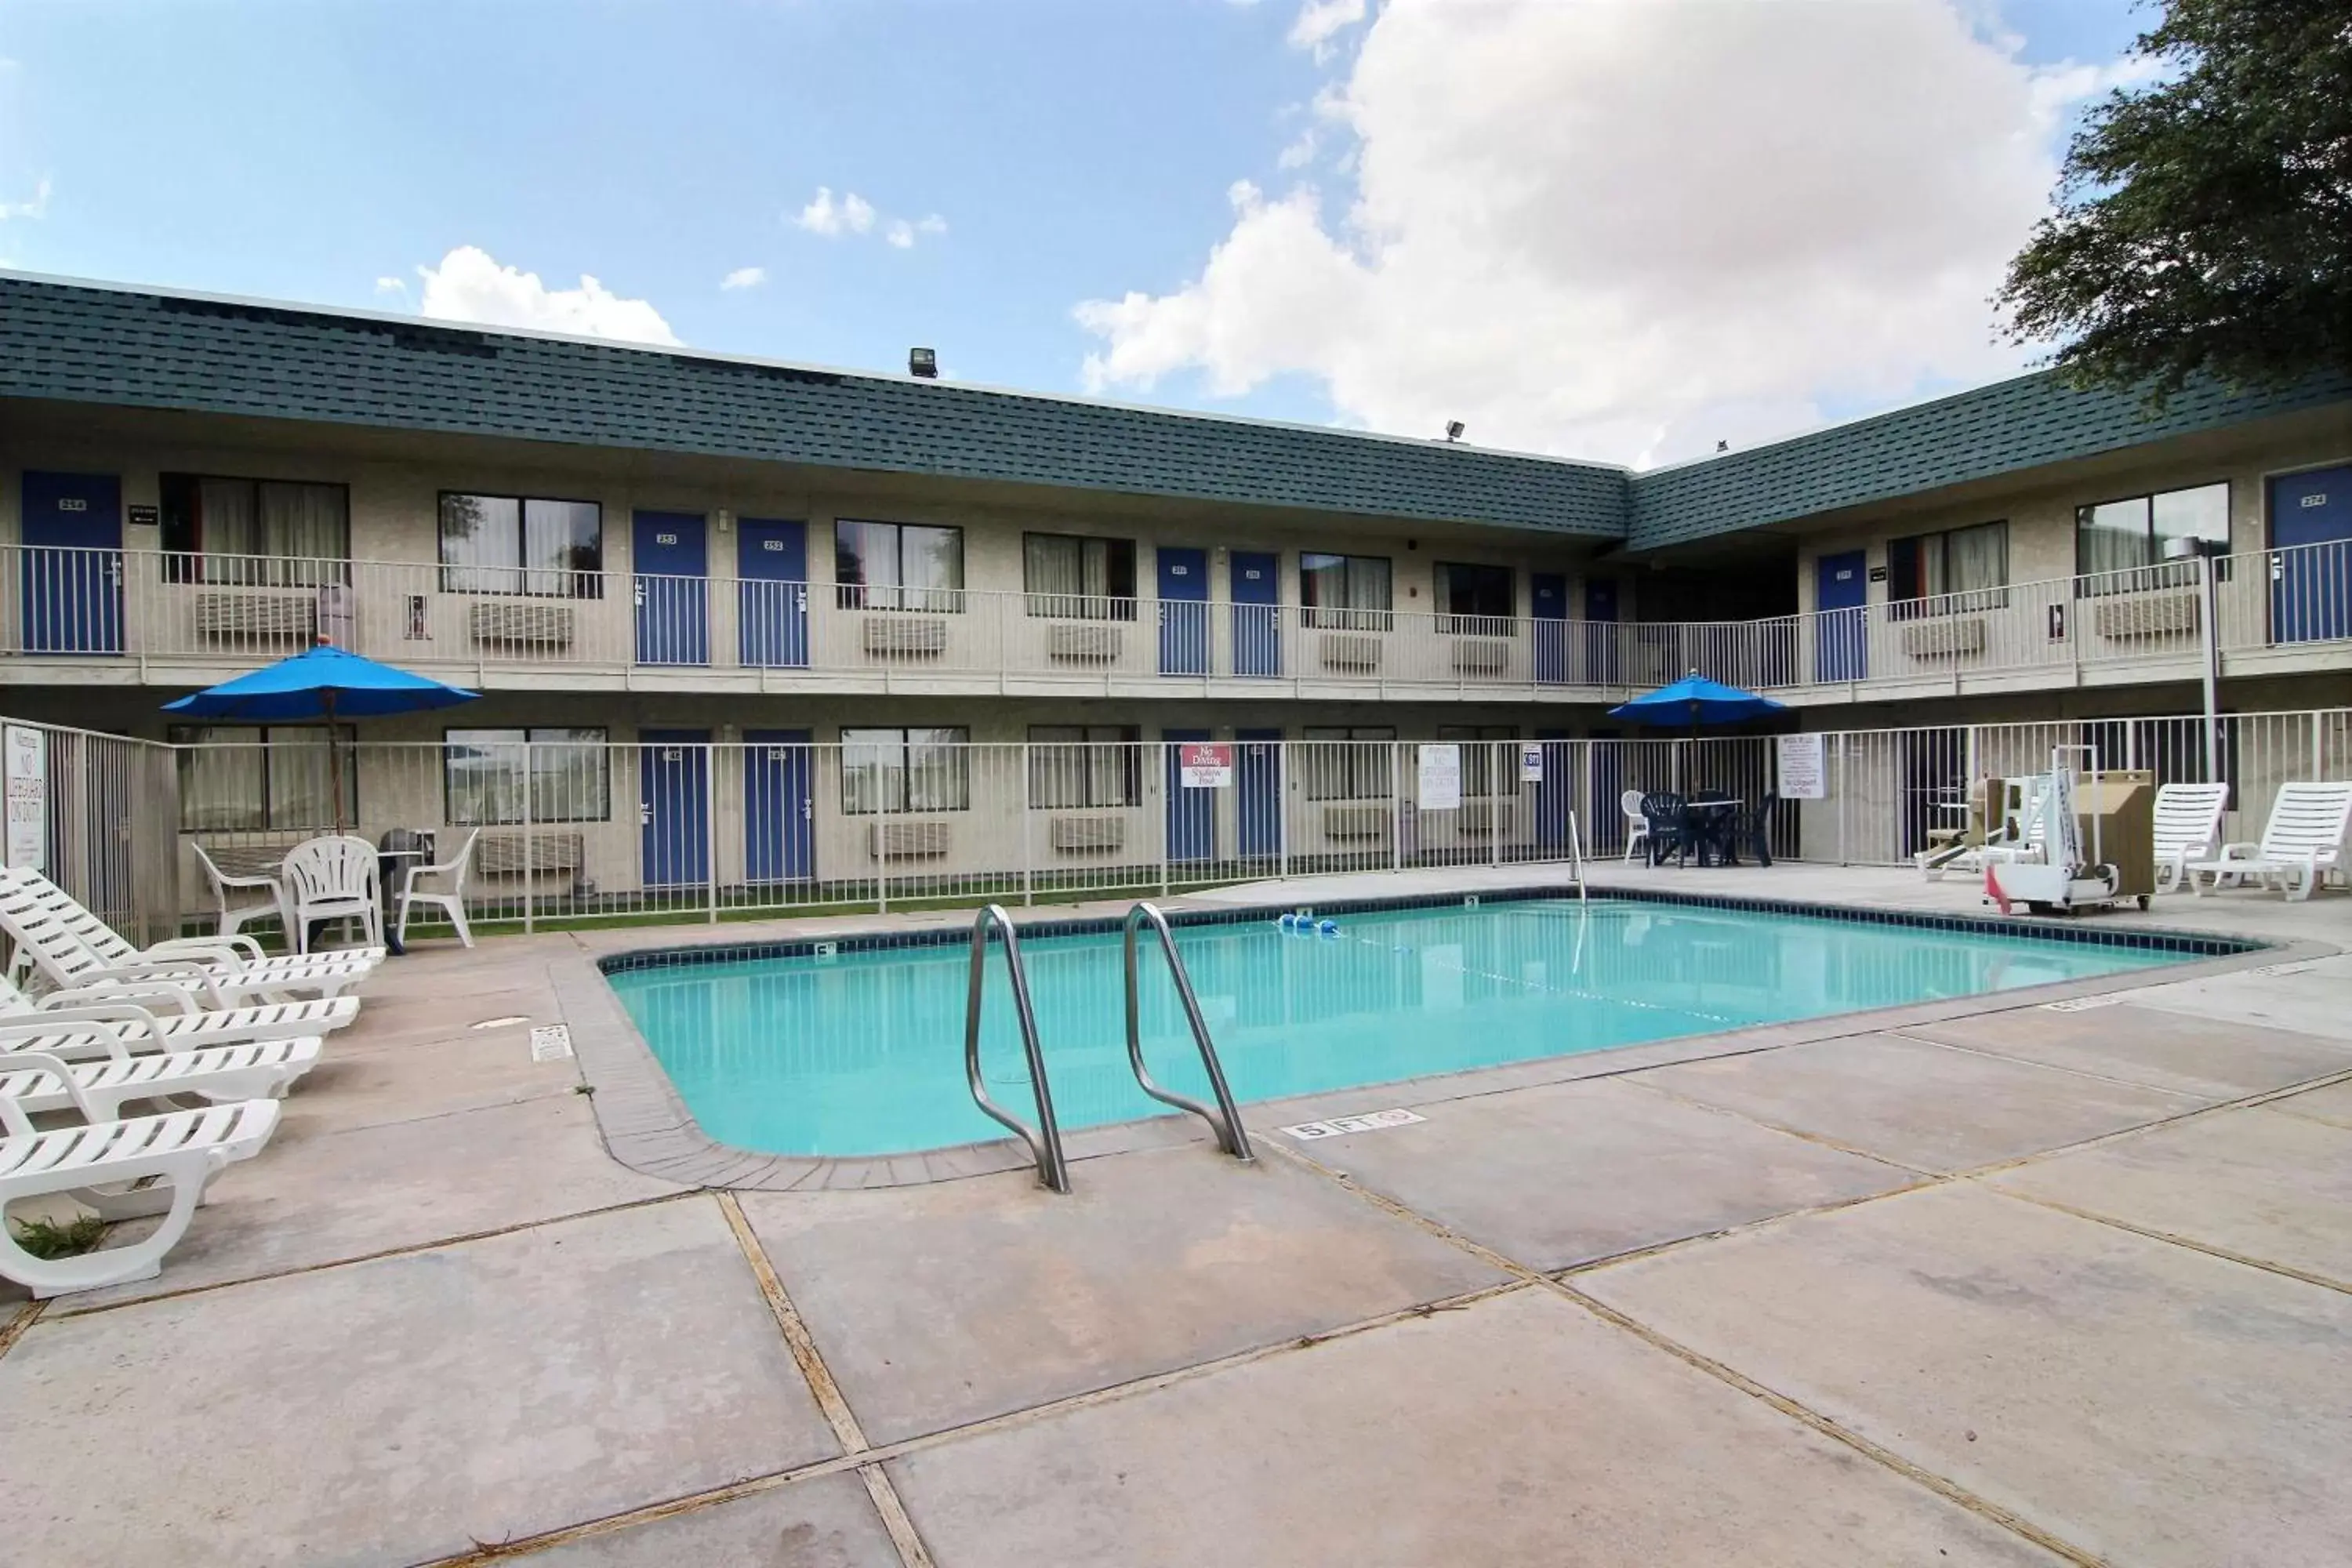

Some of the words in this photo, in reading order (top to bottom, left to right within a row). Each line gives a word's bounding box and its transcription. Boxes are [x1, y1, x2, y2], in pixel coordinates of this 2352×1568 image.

[1200, 746, 1213, 755] No
[1192, 755, 1221, 768] Diving
[1296, 1124, 1327, 1137] 5
[1332, 1116, 1377, 1131] FT
